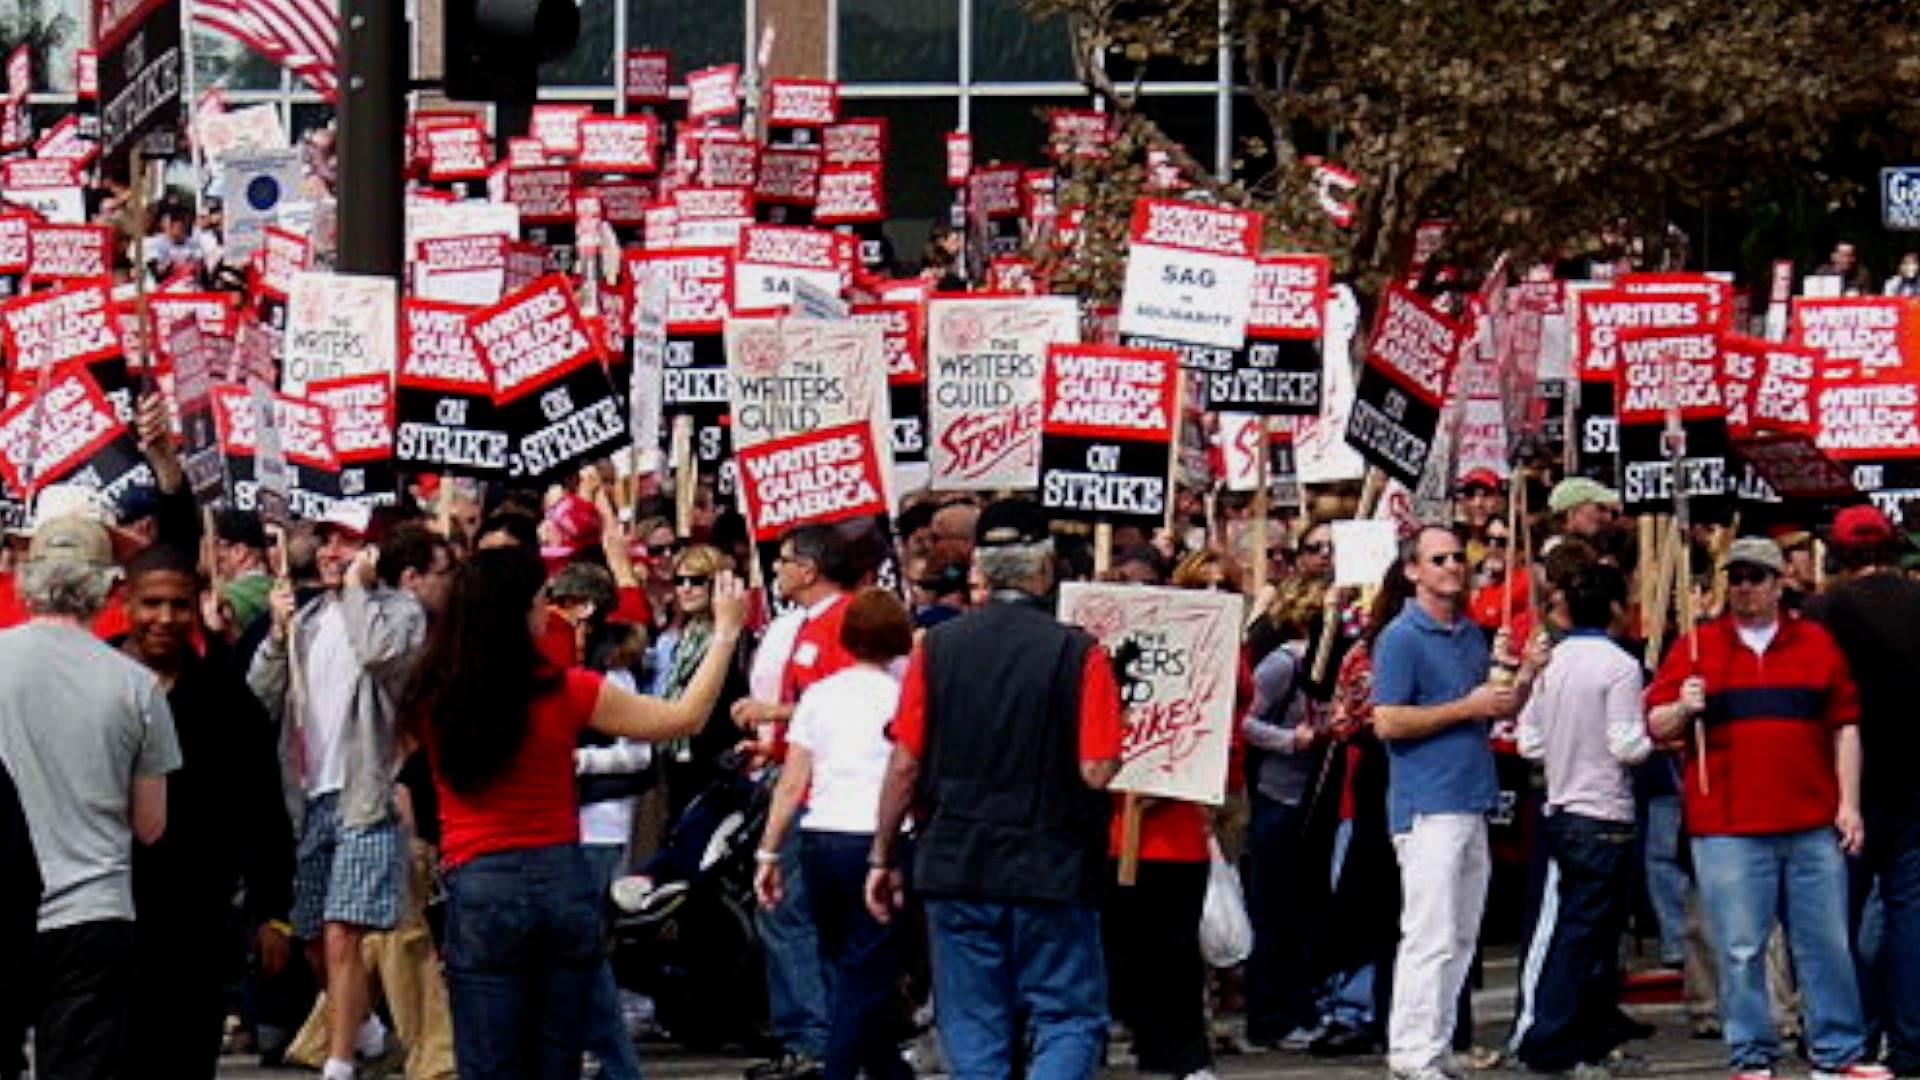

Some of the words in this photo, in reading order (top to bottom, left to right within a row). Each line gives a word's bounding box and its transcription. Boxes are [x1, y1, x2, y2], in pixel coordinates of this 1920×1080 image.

[763, 278, 791, 293] SA
[1162, 265, 1217, 288] SAG
[472, 287, 566, 346] WRITERS
[1586, 302, 1699, 326] WRITERS
[1801, 304, 1900, 328] WRITERS
[294, 330, 364, 358] WRITERS
[486, 317, 554, 367] GUILD
[1802, 327, 1877, 348] GUILD
[493, 329, 589, 394] AMERICA
[937, 355, 1035, 378] WRITERS
[1051, 356, 1164, 382] WRITERS
[1249, 344, 1279, 368] ON
[664, 369, 732, 401] RIKE
[936, 382, 1014, 408] GUILD
[1056, 380, 1137, 405] GUILD
[1135, 385, 1161, 404] OF
[1209, 372, 1319, 406] STRIKE
[1819, 384, 1919, 407] WRITERS
[436, 399, 468, 425] ON
[541, 385, 573, 421] ON
[1047, 401, 1169, 429] AMERICA
[739, 405, 822, 432] GUILD
[1821, 406, 1891, 430] GUILD
[397, 422, 508, 468] STRIKE
[521, 396, 625, 476] STRIKE
[1349, 399, 1427, 477] STRIKE
[1816, 425, 1920, 449] AMERICA
[745, 434, 861, 478] WRITERS
[1087, 444, 1120, 472] ON
[758, 465, 842, 500] GUILD
[841, 463, 864, 481] OF
[1043, 468, 1163, 515] STRIKE
[1624, 456, 1725, 503] STRKE
[1853, 465, 1884, 491] ON
[757, 480, 878, 526] AMERICA
